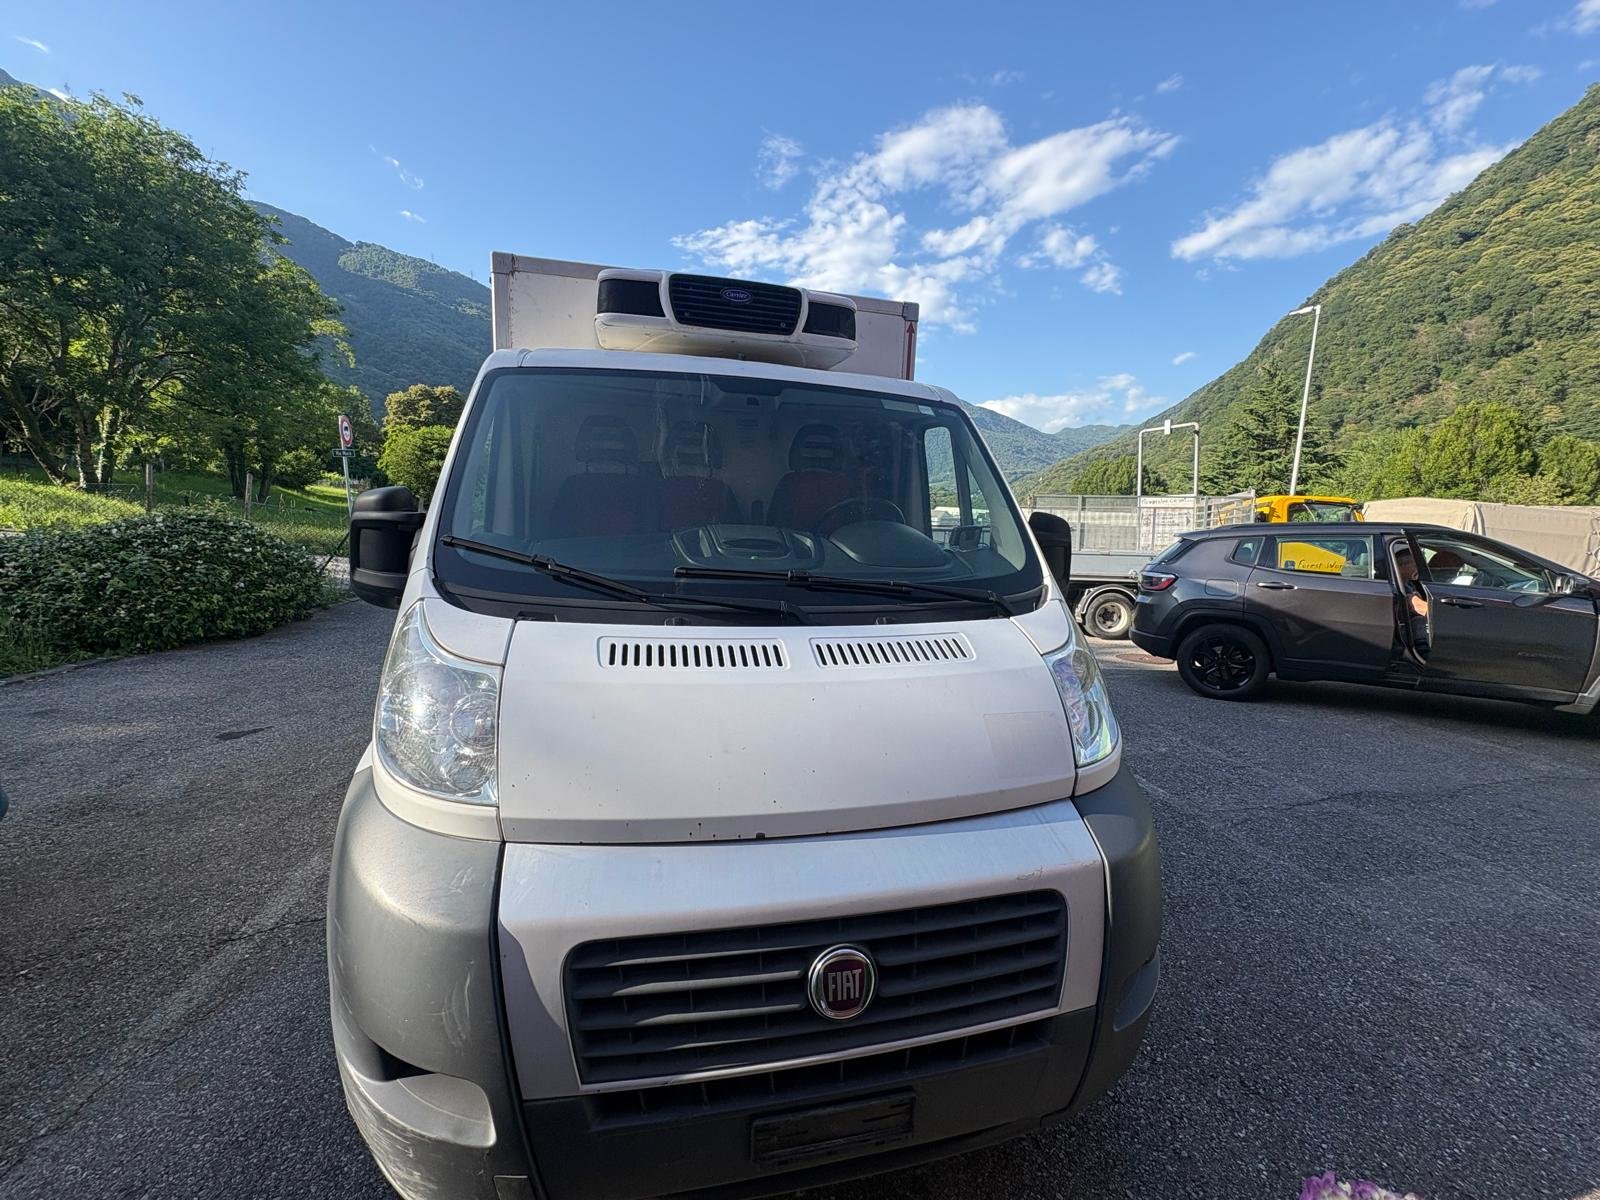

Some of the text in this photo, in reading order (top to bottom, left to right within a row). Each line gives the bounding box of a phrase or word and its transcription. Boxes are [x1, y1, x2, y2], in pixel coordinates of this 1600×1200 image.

[725, 291, 748, 299] Carrier
[1298, 559, 1322, 570] Forest
[827, 968, 862, 1002] FIAT
